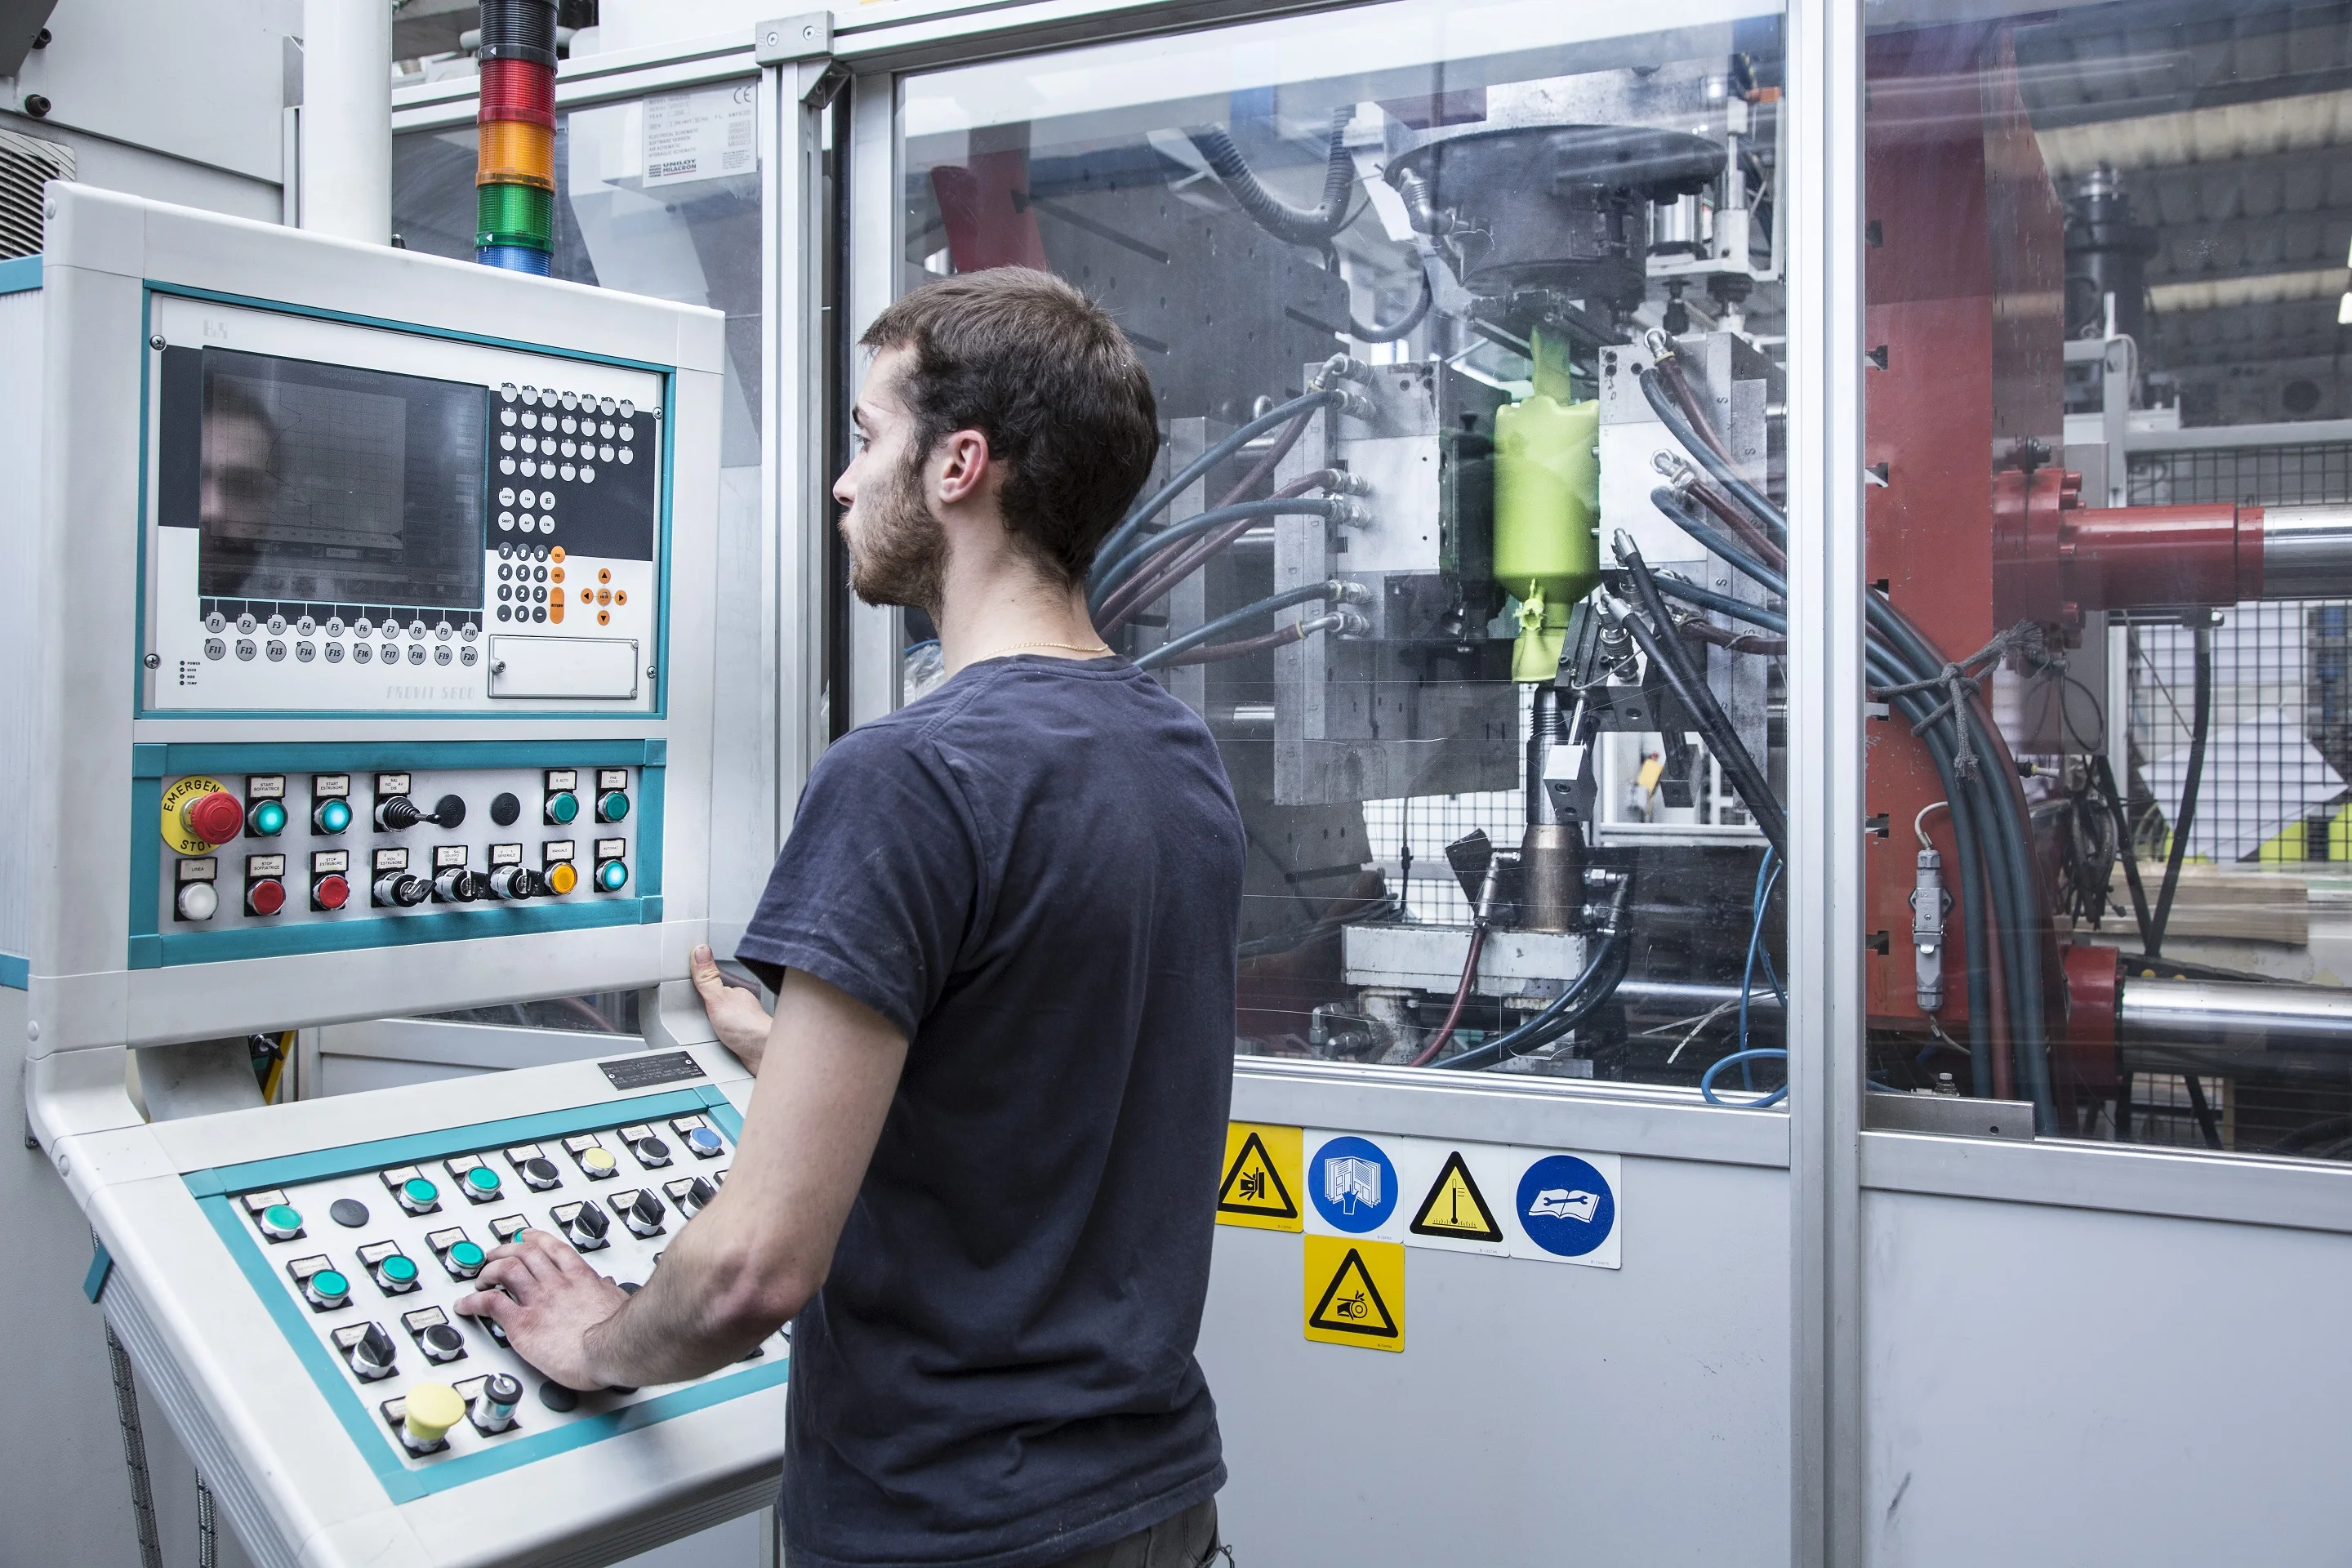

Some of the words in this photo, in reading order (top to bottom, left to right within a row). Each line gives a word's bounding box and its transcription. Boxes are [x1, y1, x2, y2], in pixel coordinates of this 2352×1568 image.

[733, 85, 751, 105] CE
[662, 158, 696, 167] UNILOY
[662, 163, 697, 173] MILACRON
[503, 547, 510, 556] 7
[520, 549, 526, 558] 8
[537, 550, 544, 559] 9
[501, 568, 508, 577] 4
[519, 568, 526, 577] 5
[537, 570, 543, 578] 6
[502, 588, 507, 597] 1
[519, 589, 525, 598] 2
[537, 590, 543, 599] 3
[519, 610, 524, 619] 0
[211, 619, 220, 627] F1
[242, 620, 252, 628] F2
[272, 621, 282, 629] F3
[302, 622, 311, 630] F4
[331, 623, 340, 631] F5
[359, 624, 368, 632] F6
[413, 626, 421, 635] F8
[440, 627, 448, 635] F9
[209, 646, 221, 654] F11
[300, 648, 313, 656] F14
[328, 648, 341, 657] F15
[386, 686, 435, 699] PROVIT
[163, 780, 220, 812] EMERGEN
